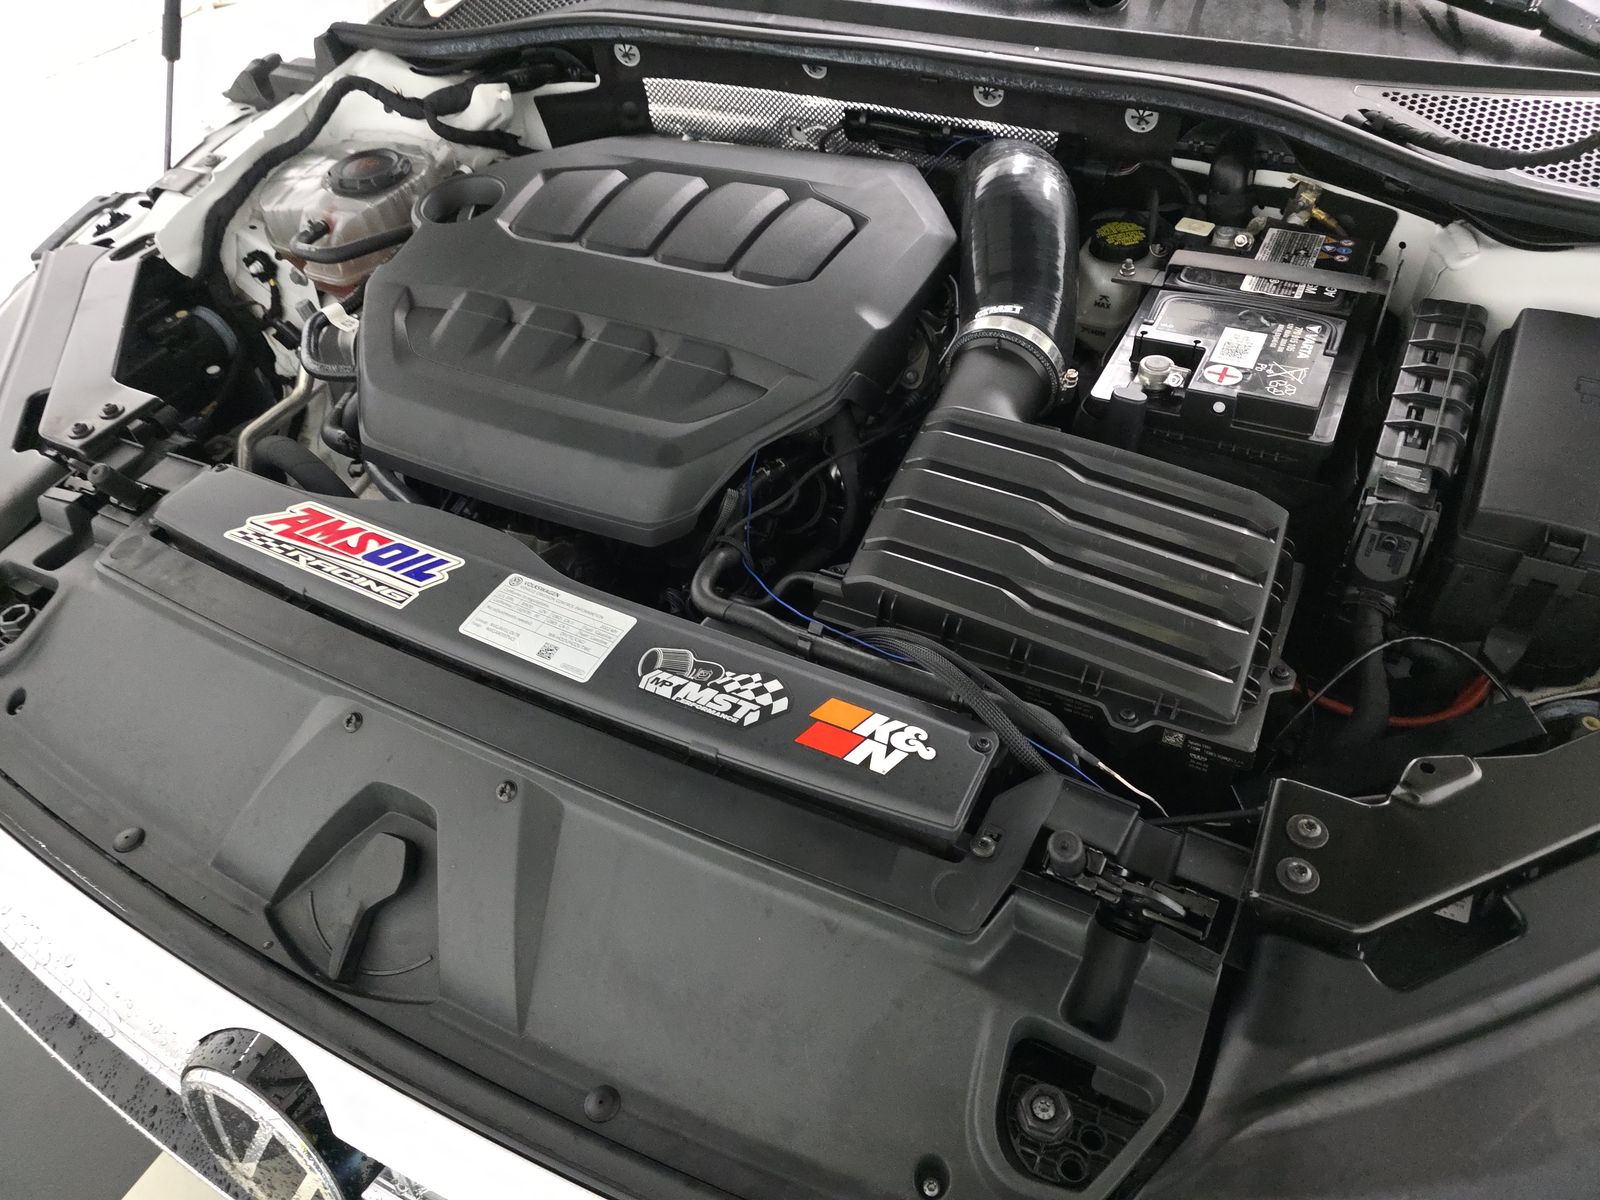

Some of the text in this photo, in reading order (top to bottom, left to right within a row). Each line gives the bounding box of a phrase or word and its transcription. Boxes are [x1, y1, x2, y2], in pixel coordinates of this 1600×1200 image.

[1297, 334, 1318, 358] VARTA
[266, 507, 451, 583] AMSOIL
[291, 550, 408, 600] RACING
[672, 681, 760, 718] MST
[675, 697, 740, 723] PERFORMANCE
